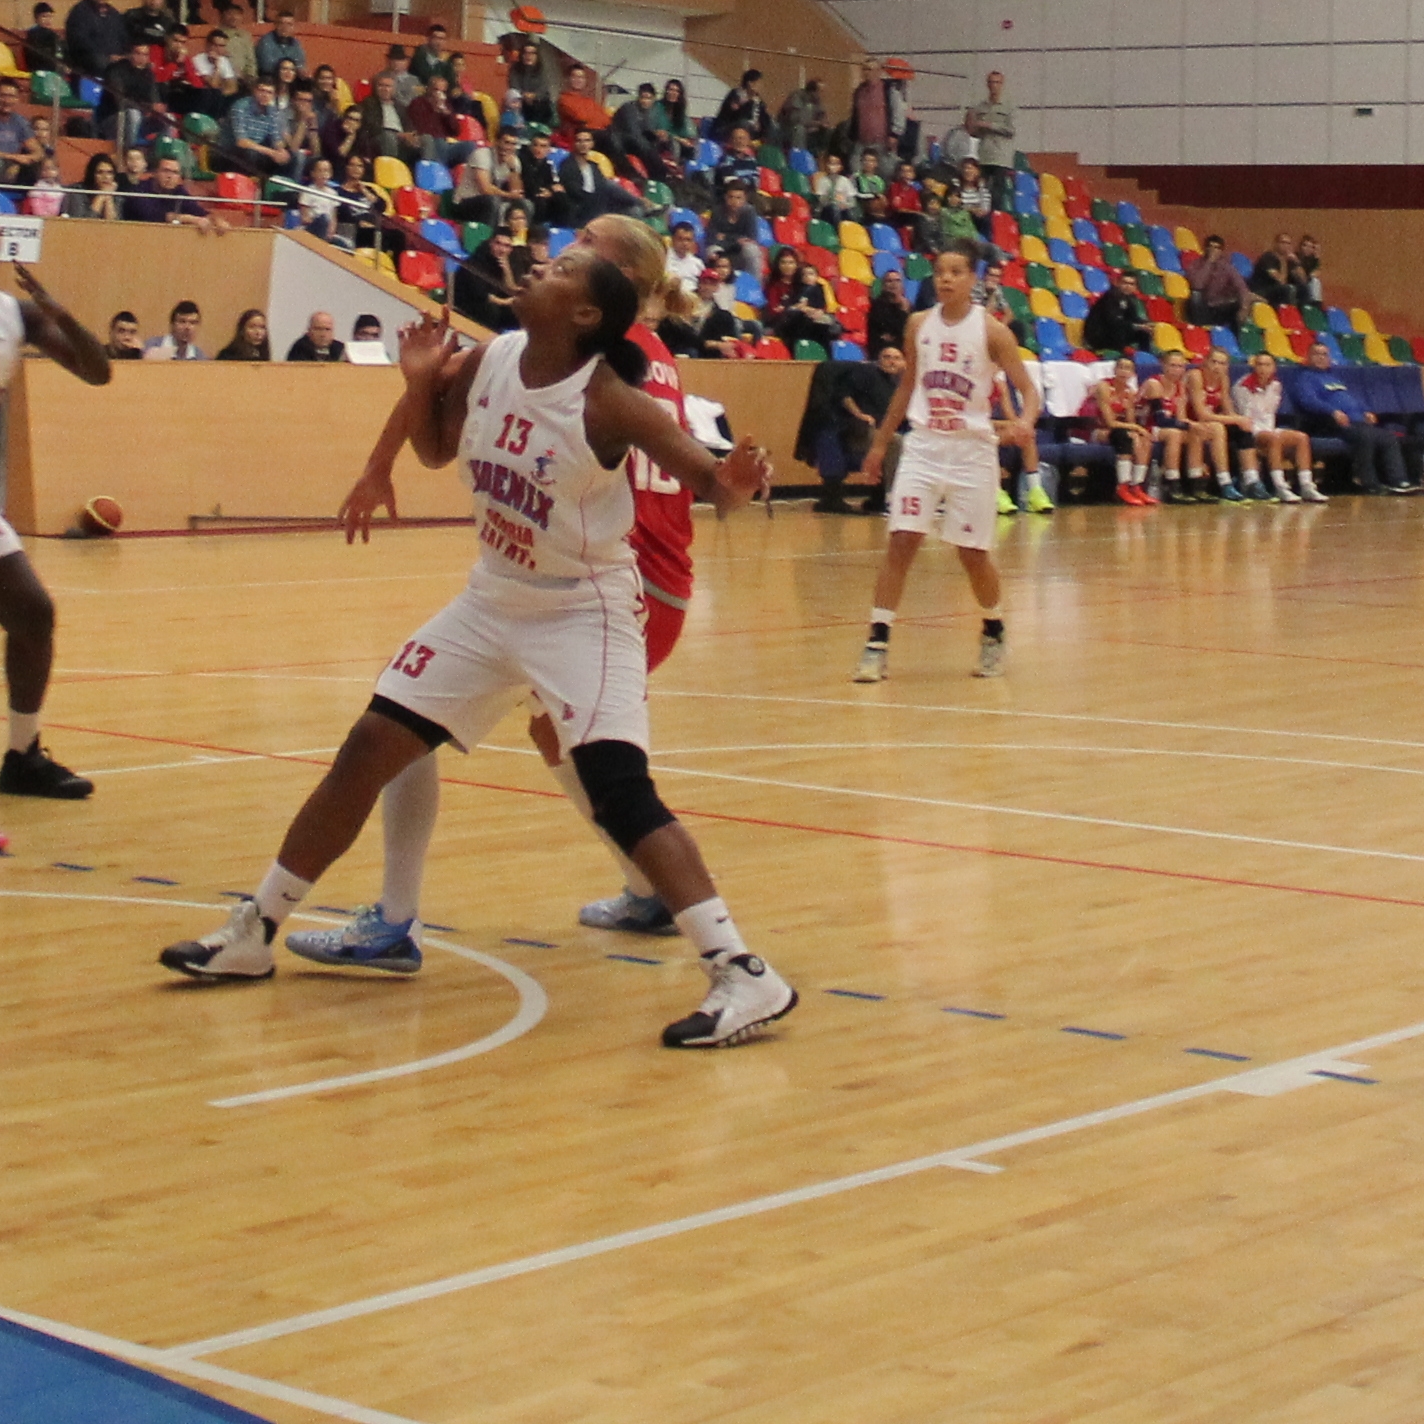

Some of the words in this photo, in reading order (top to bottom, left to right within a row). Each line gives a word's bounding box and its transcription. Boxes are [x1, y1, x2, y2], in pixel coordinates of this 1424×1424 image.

[940, 342, 958, 363] 15
[495, 414, 534, 455] 13
[902, 497, 920, 516] 15
[392, 640, 437, 678] 13
